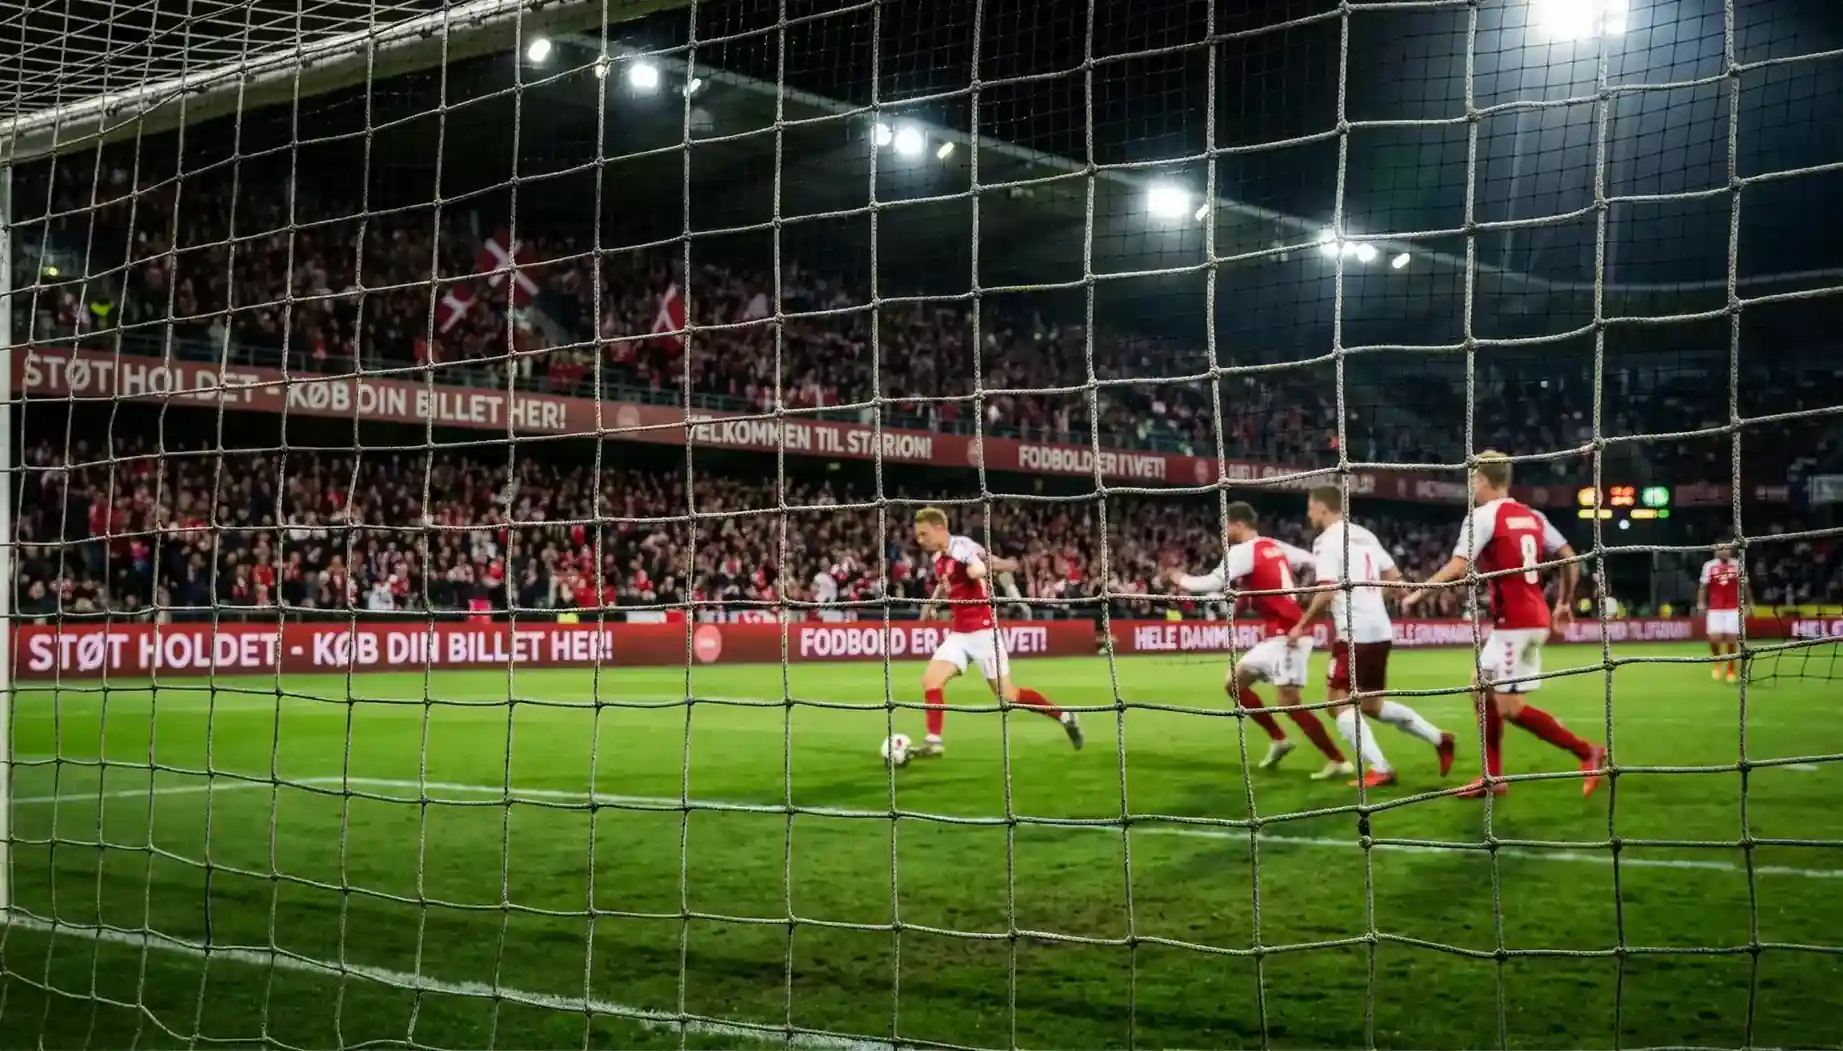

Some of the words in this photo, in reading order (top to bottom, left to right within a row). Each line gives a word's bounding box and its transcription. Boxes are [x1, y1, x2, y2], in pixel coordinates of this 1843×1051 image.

[24, 354, 113, 392] STØT
[124, 364, 258, 402] HOLDET
[287, 379, 350, 411] KØB
[359, 384, 406, 416] DIN
[416, 389, 503, 423] BILLET
[511, 400, 566, 429] HER!
[815, 427, 843, 453] TIL
[1019, 445, 1093, 472] FODBOLD
[1134, 625, 1177, 649] HELE
[29, 632, 129, 671] STØT
[139, 633, 278, 669] HOLDET
[313, 631, 378, 666] KØB
[387, 632, 439, 663] DIN
[449, 631, 544, 662] BILLET
